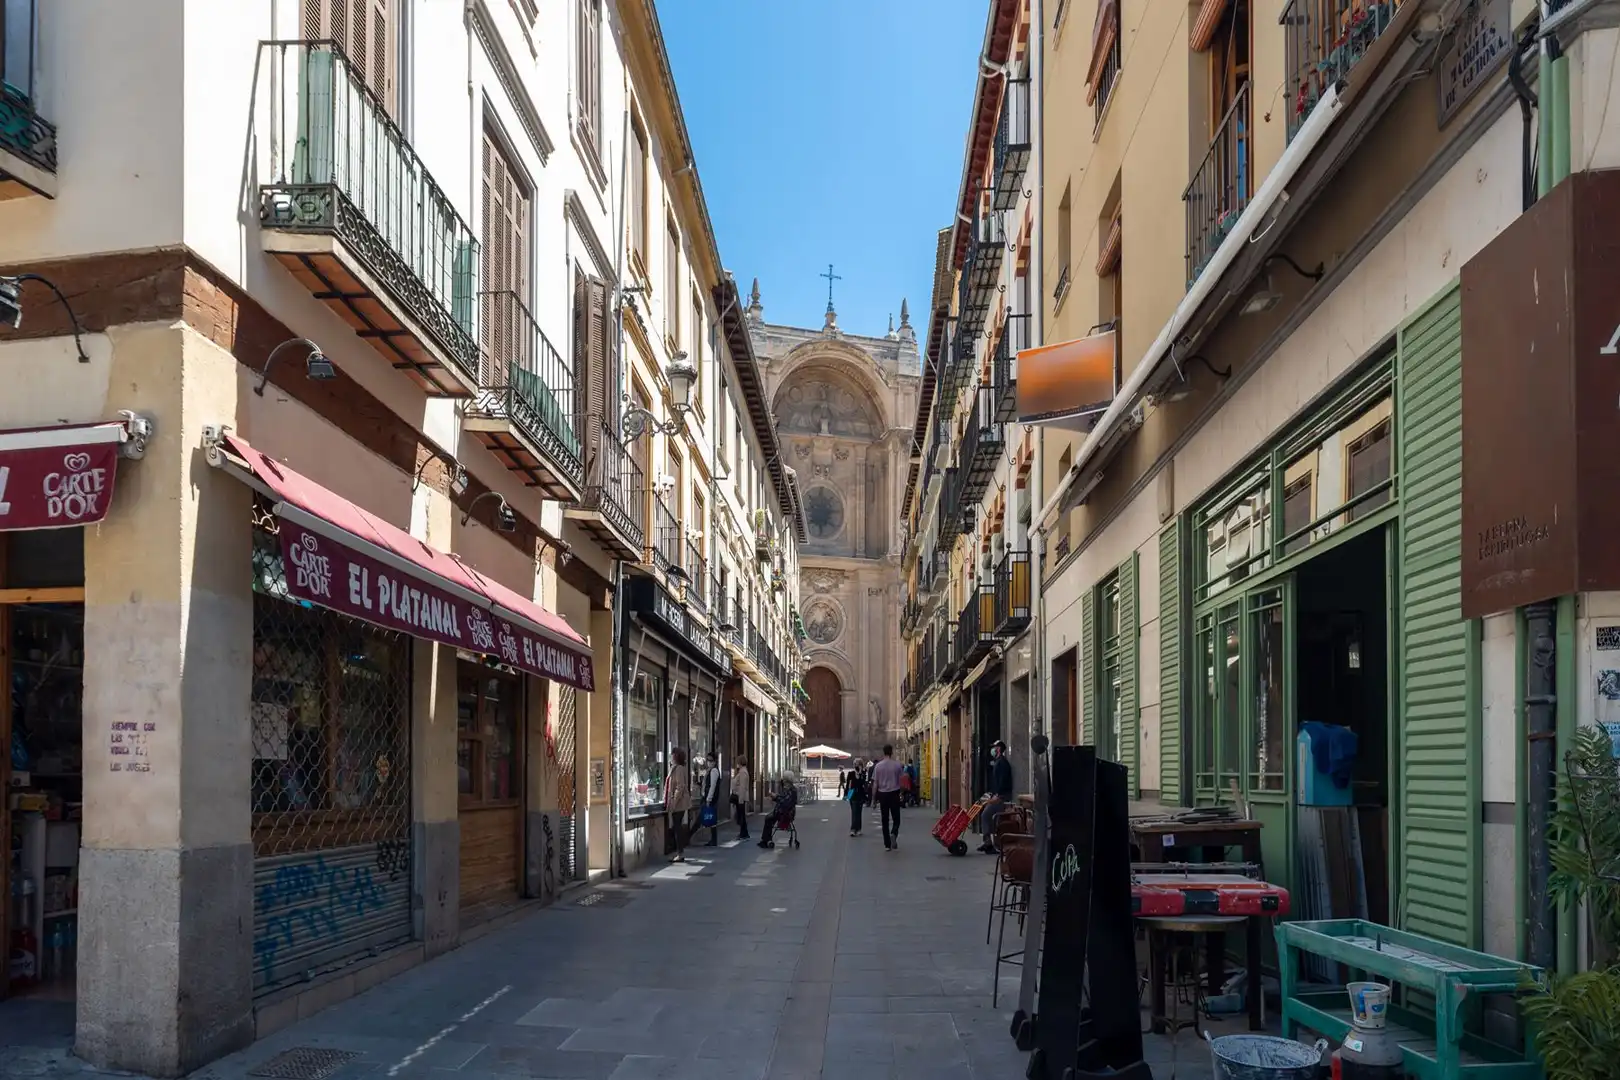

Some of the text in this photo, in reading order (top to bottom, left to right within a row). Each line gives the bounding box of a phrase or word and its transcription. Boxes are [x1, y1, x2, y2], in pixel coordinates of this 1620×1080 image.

[43, 468, 106, 497] CARTE
[1478, 514, 1529, 546] TABERNA
[290, 543, 332, 579] CARTE
[348, 562, 462, 639] EL PLATANAL
[466, 615, 493, 635] CARTE
[522, 636, 576, 681] EL PLATANAL
